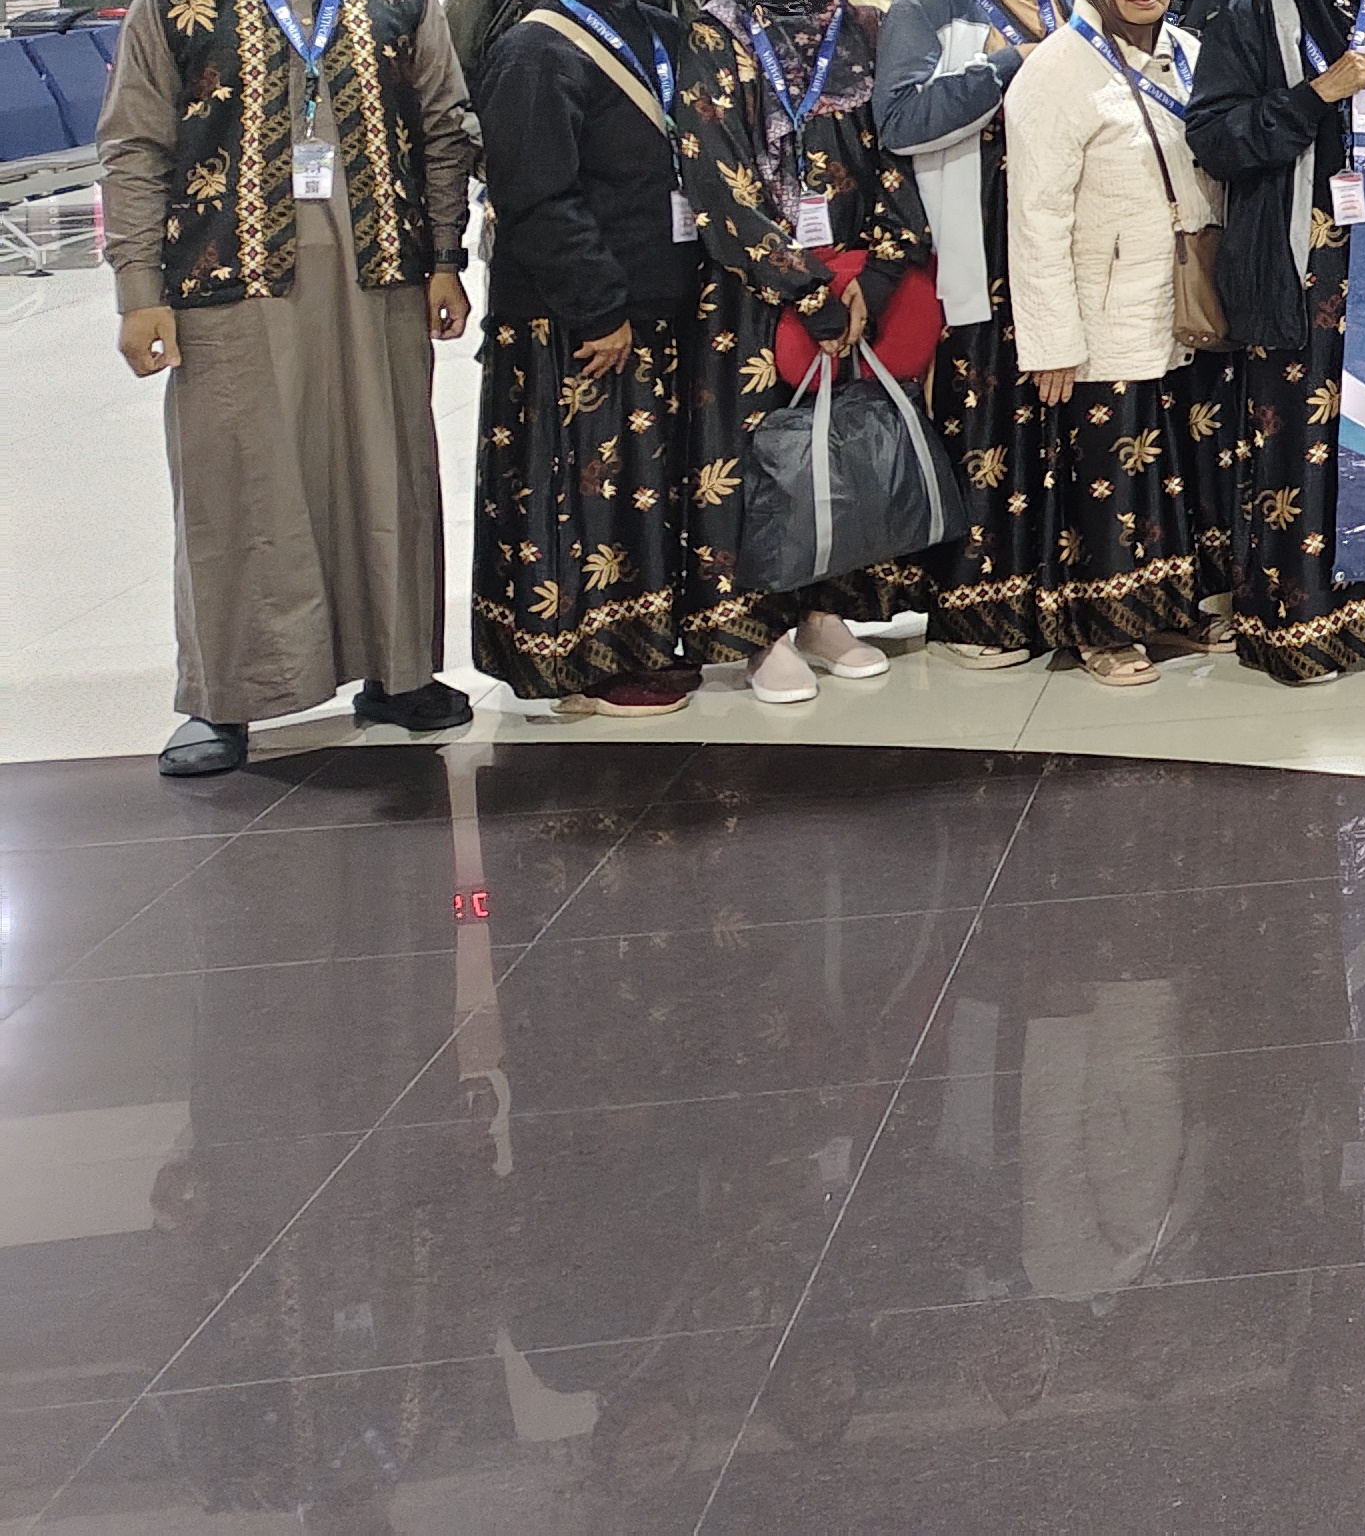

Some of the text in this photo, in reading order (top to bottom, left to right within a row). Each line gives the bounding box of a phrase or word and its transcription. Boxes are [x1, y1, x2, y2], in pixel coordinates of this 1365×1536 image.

[318, 5, 334, 36] DALWA
[585, 14, 613, 41] DALWA
[762, 50, 780, 80] DALWA
[1147, 85, 1174, 107] DALWA
